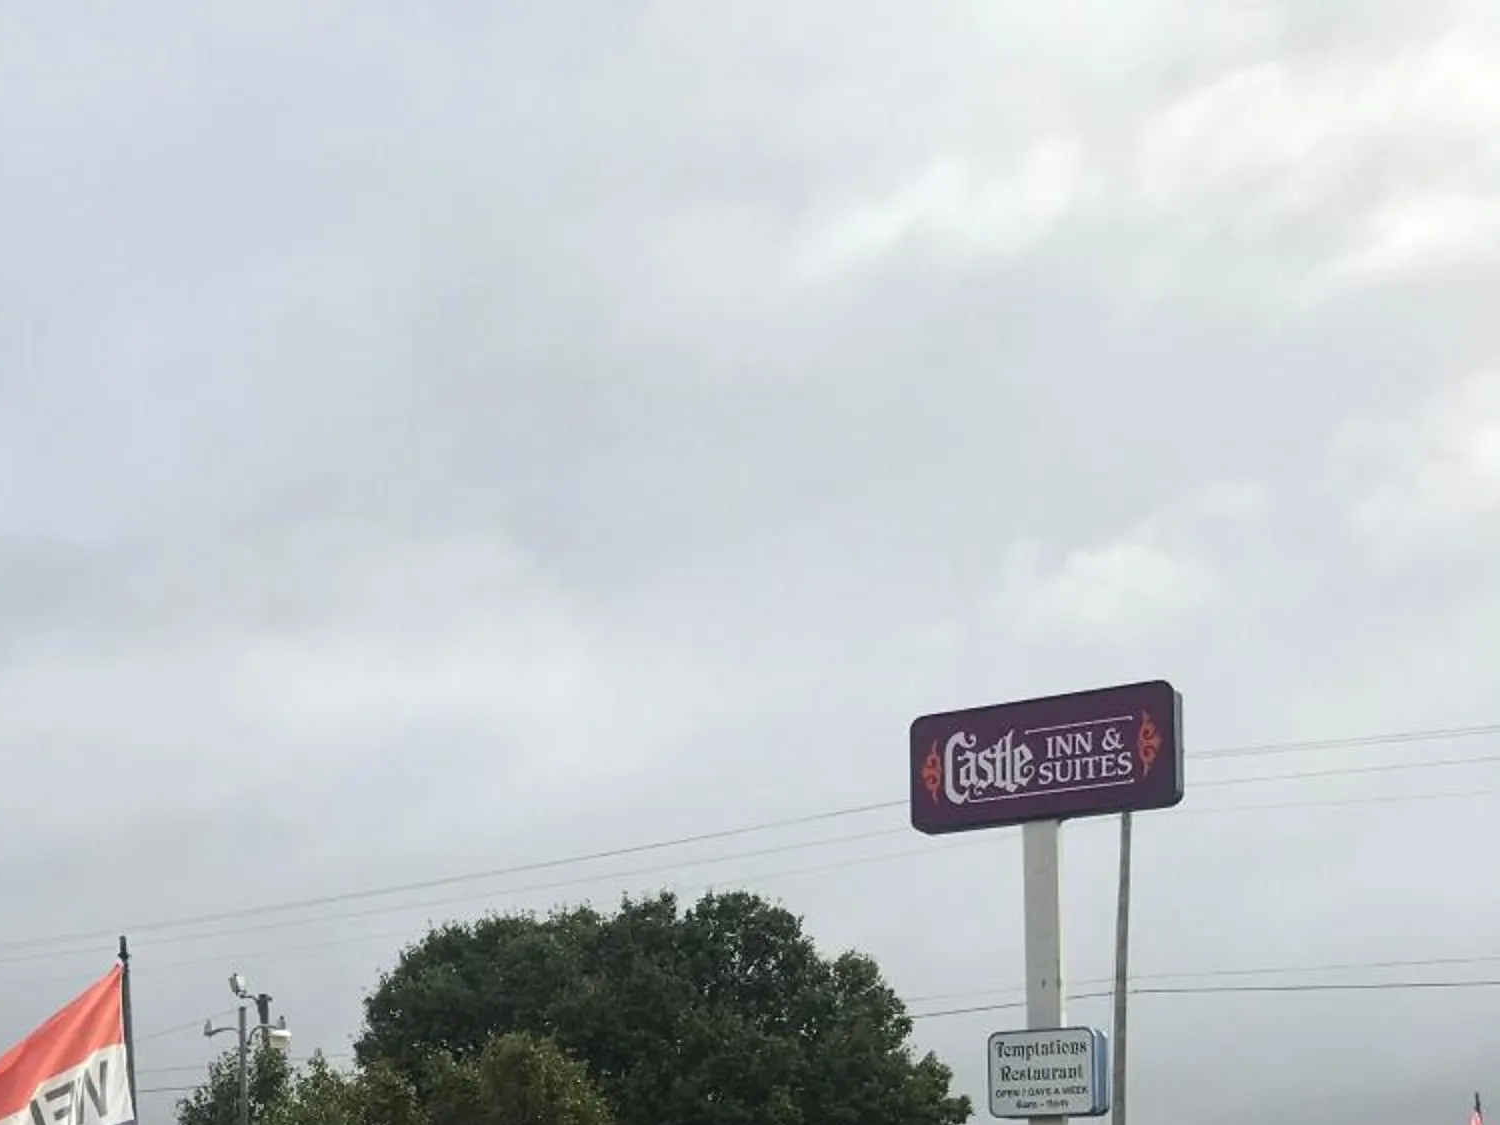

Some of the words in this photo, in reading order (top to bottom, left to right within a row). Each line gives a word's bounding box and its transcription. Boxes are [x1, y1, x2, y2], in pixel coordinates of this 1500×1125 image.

[1046, 731, 1093, 759] INN
[1101, 727, 1124, 751] &
[944, 729, 1035, 805] Castle
[1038, 752, 1133, 785] SUITES
[996, 1039, 1088, 1061] Temptations
[1000, 1063, 1083, 1081] Restaurant
